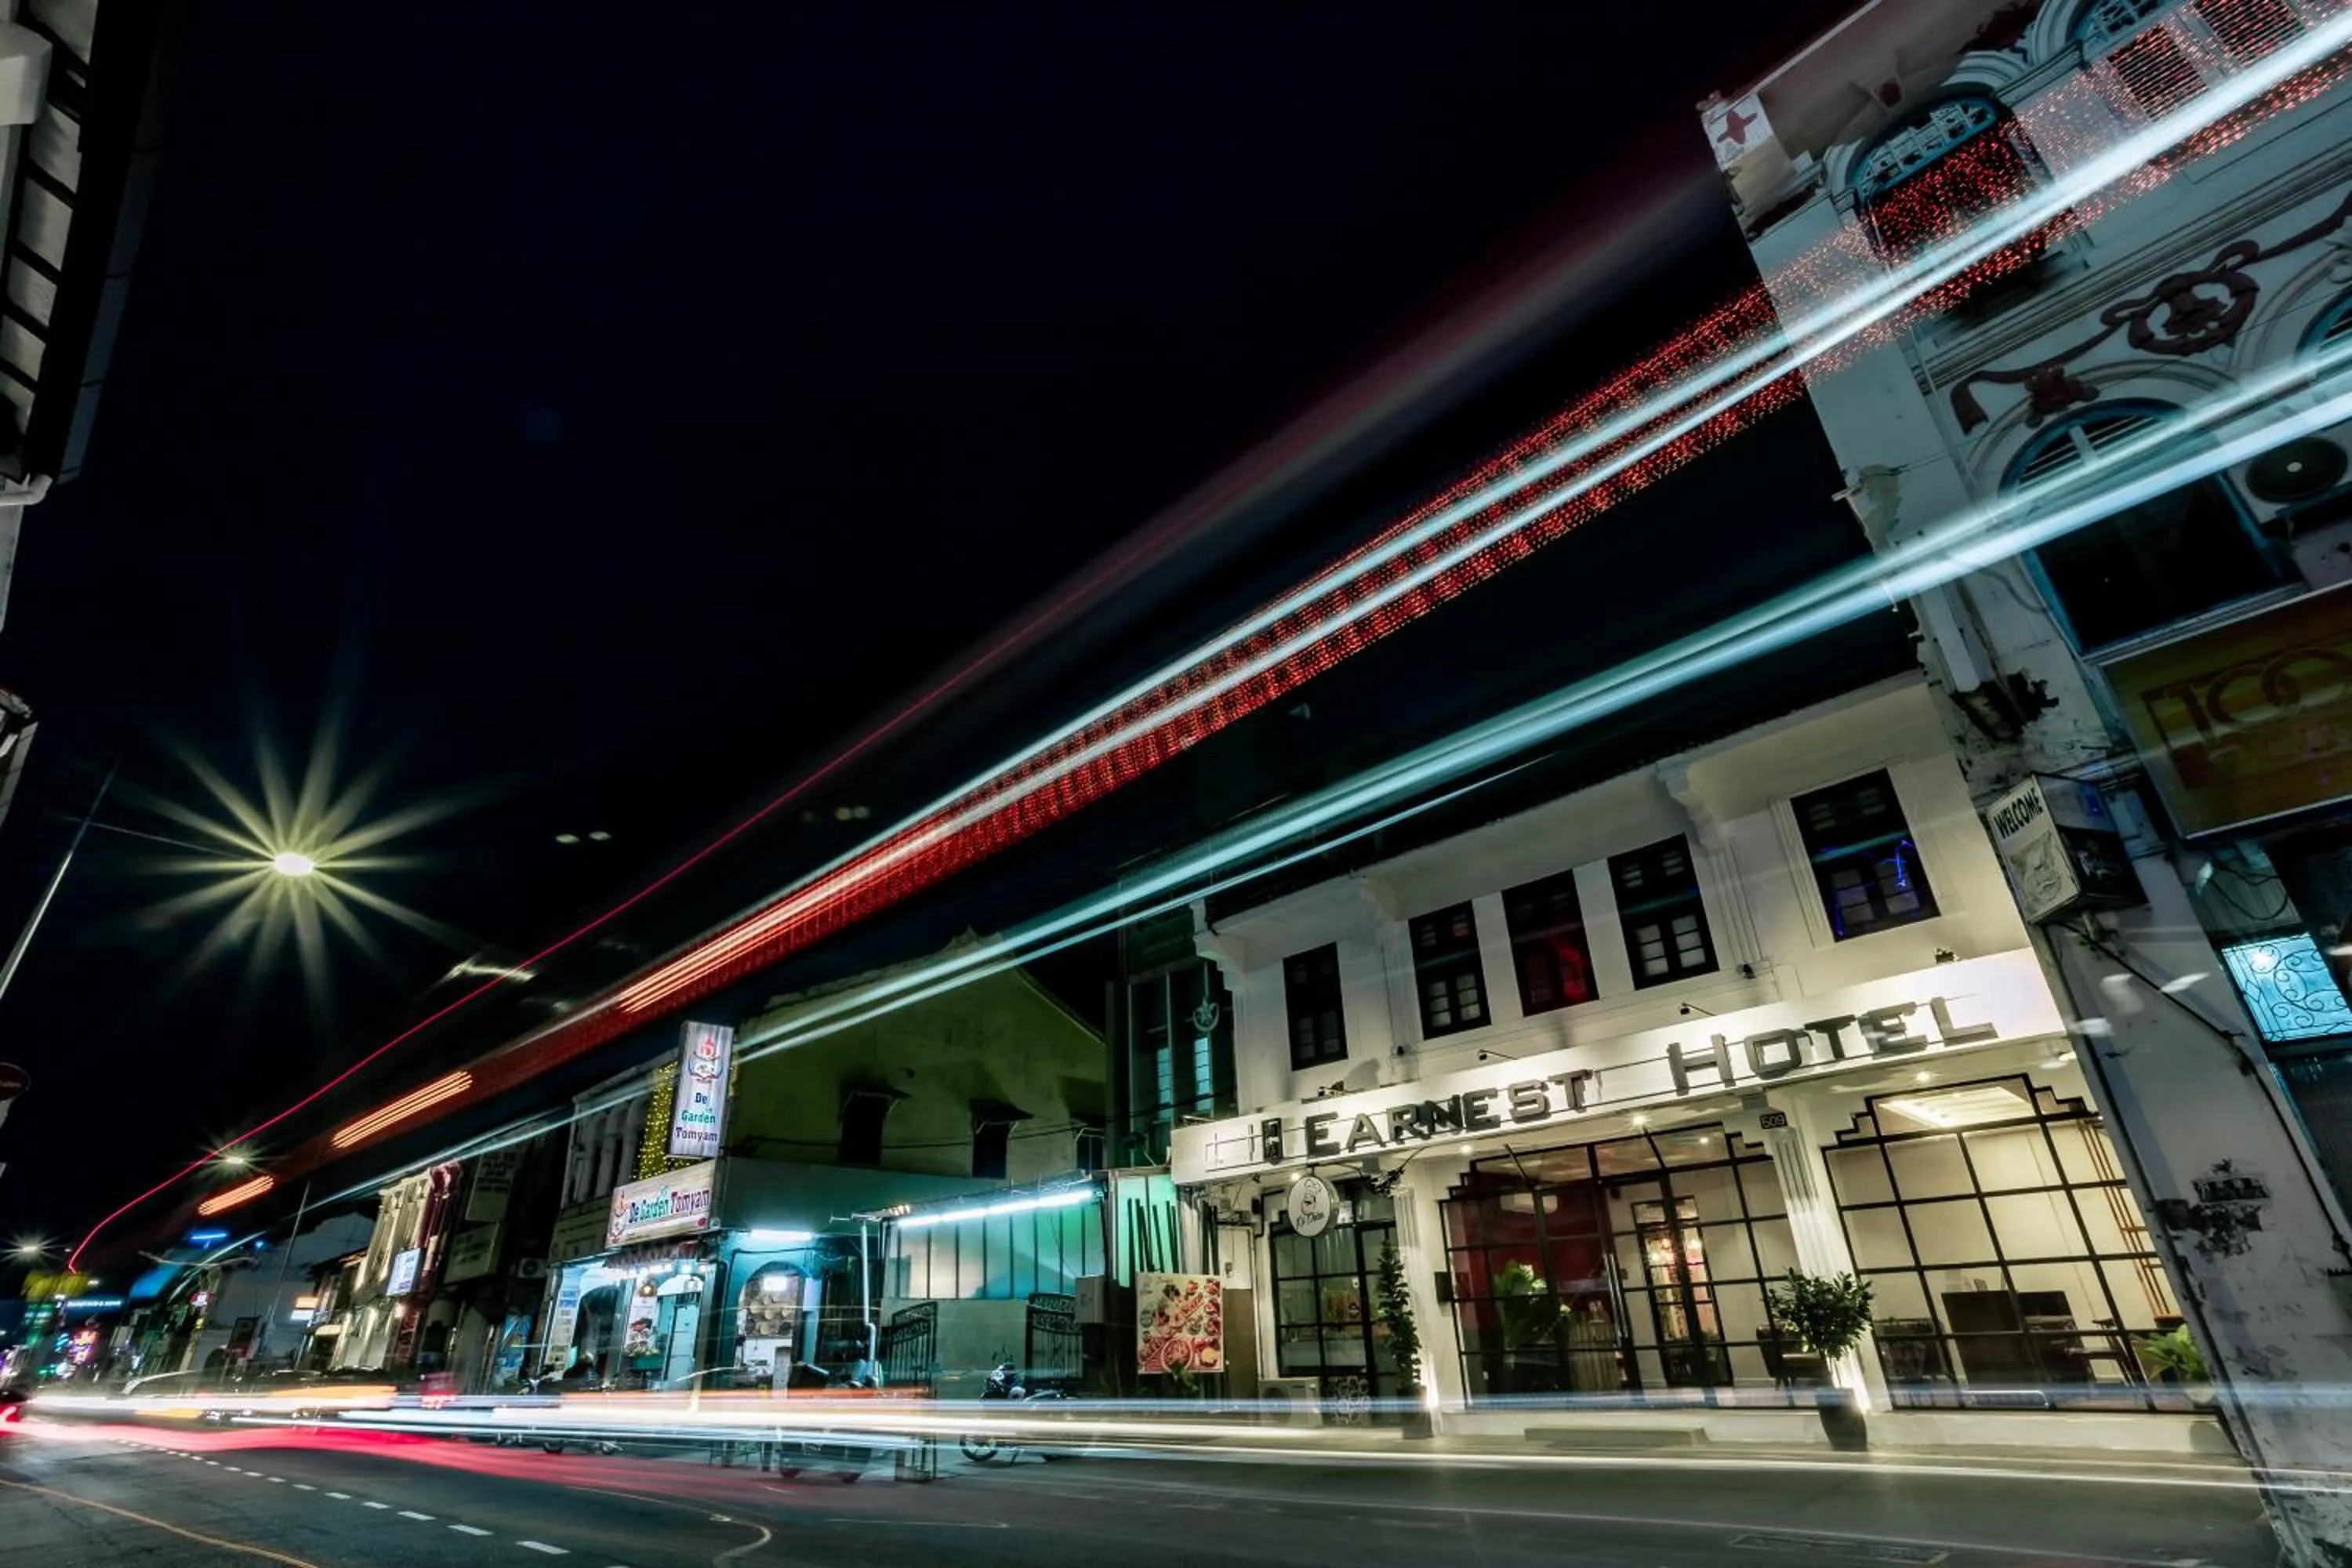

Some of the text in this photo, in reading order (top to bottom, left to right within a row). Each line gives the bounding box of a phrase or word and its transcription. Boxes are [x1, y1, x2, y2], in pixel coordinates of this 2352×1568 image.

[1994, 787, 2044, 839] WELCOME
[1666, 996, 1999, 1096] HOTEL
[695, 1092, 707, 1105] De
[681, 1109, 716, 1124] Garden
[676, 1127, 717, 1142] Tomyam
[670, 1189, 710, 1215] Tomyam
